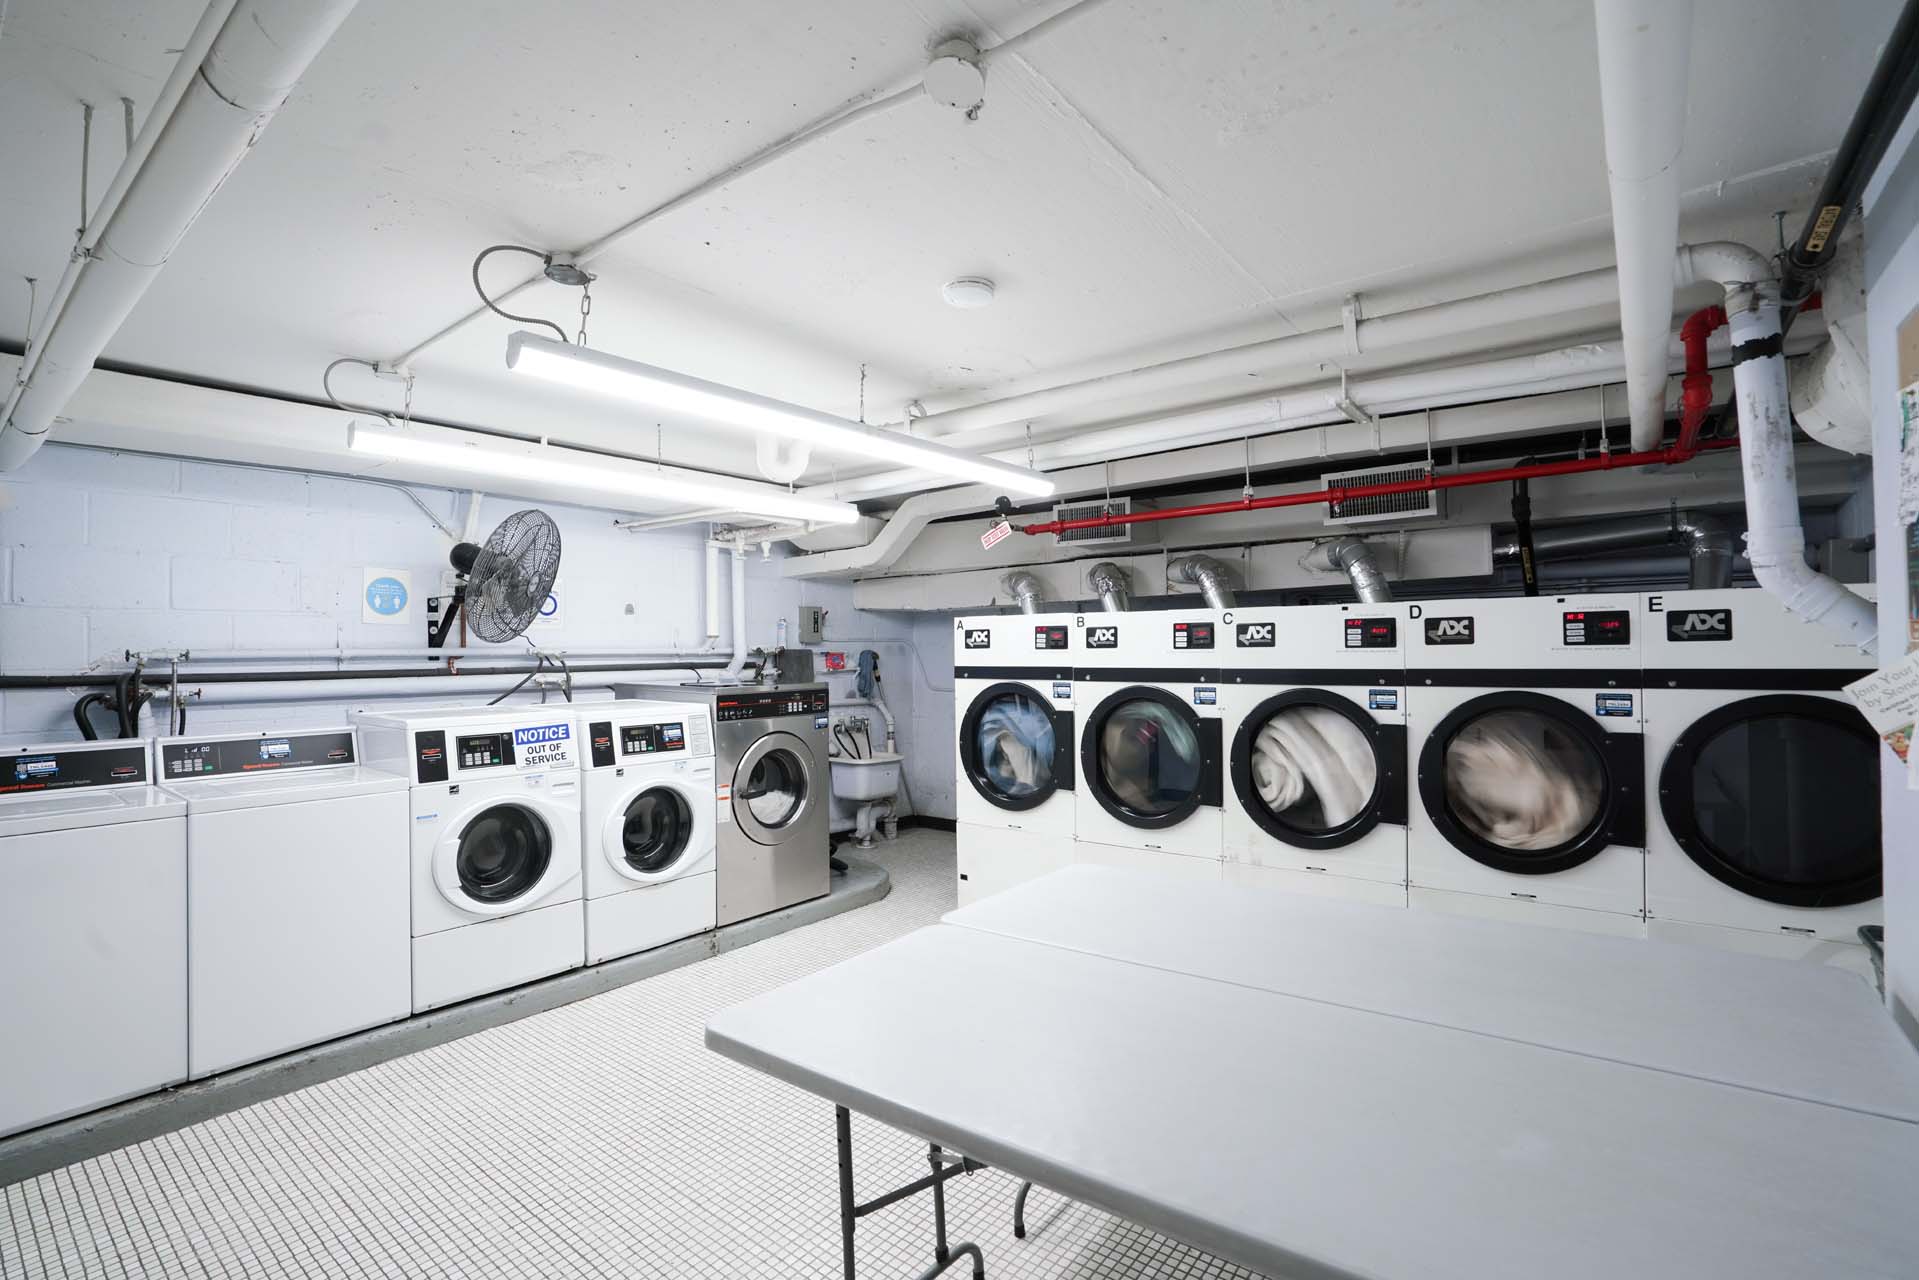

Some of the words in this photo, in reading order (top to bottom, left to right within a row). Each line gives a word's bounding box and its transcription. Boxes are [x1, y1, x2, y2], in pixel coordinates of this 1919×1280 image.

[1648, 596, 1663, 612] E
[1222, 612, 1233, 625] C
[1409, 605, 1422, 619] D
[956, 620, 964, 630] A
[1076, 617, 1085, 627] B
[1437, 619, 1469, 635] ADC
[1683, 612, 1726, 631] ADC
[1094, 629, 1115, 641] ADC
[1245, 625, 1272, 639] ADC
[518, 726, 567, 743] NOTICE
[527, 744, 546, 755] OUT
[549, 743, 562, 752] OF
[525, 752, 567, 766] SERVICE
